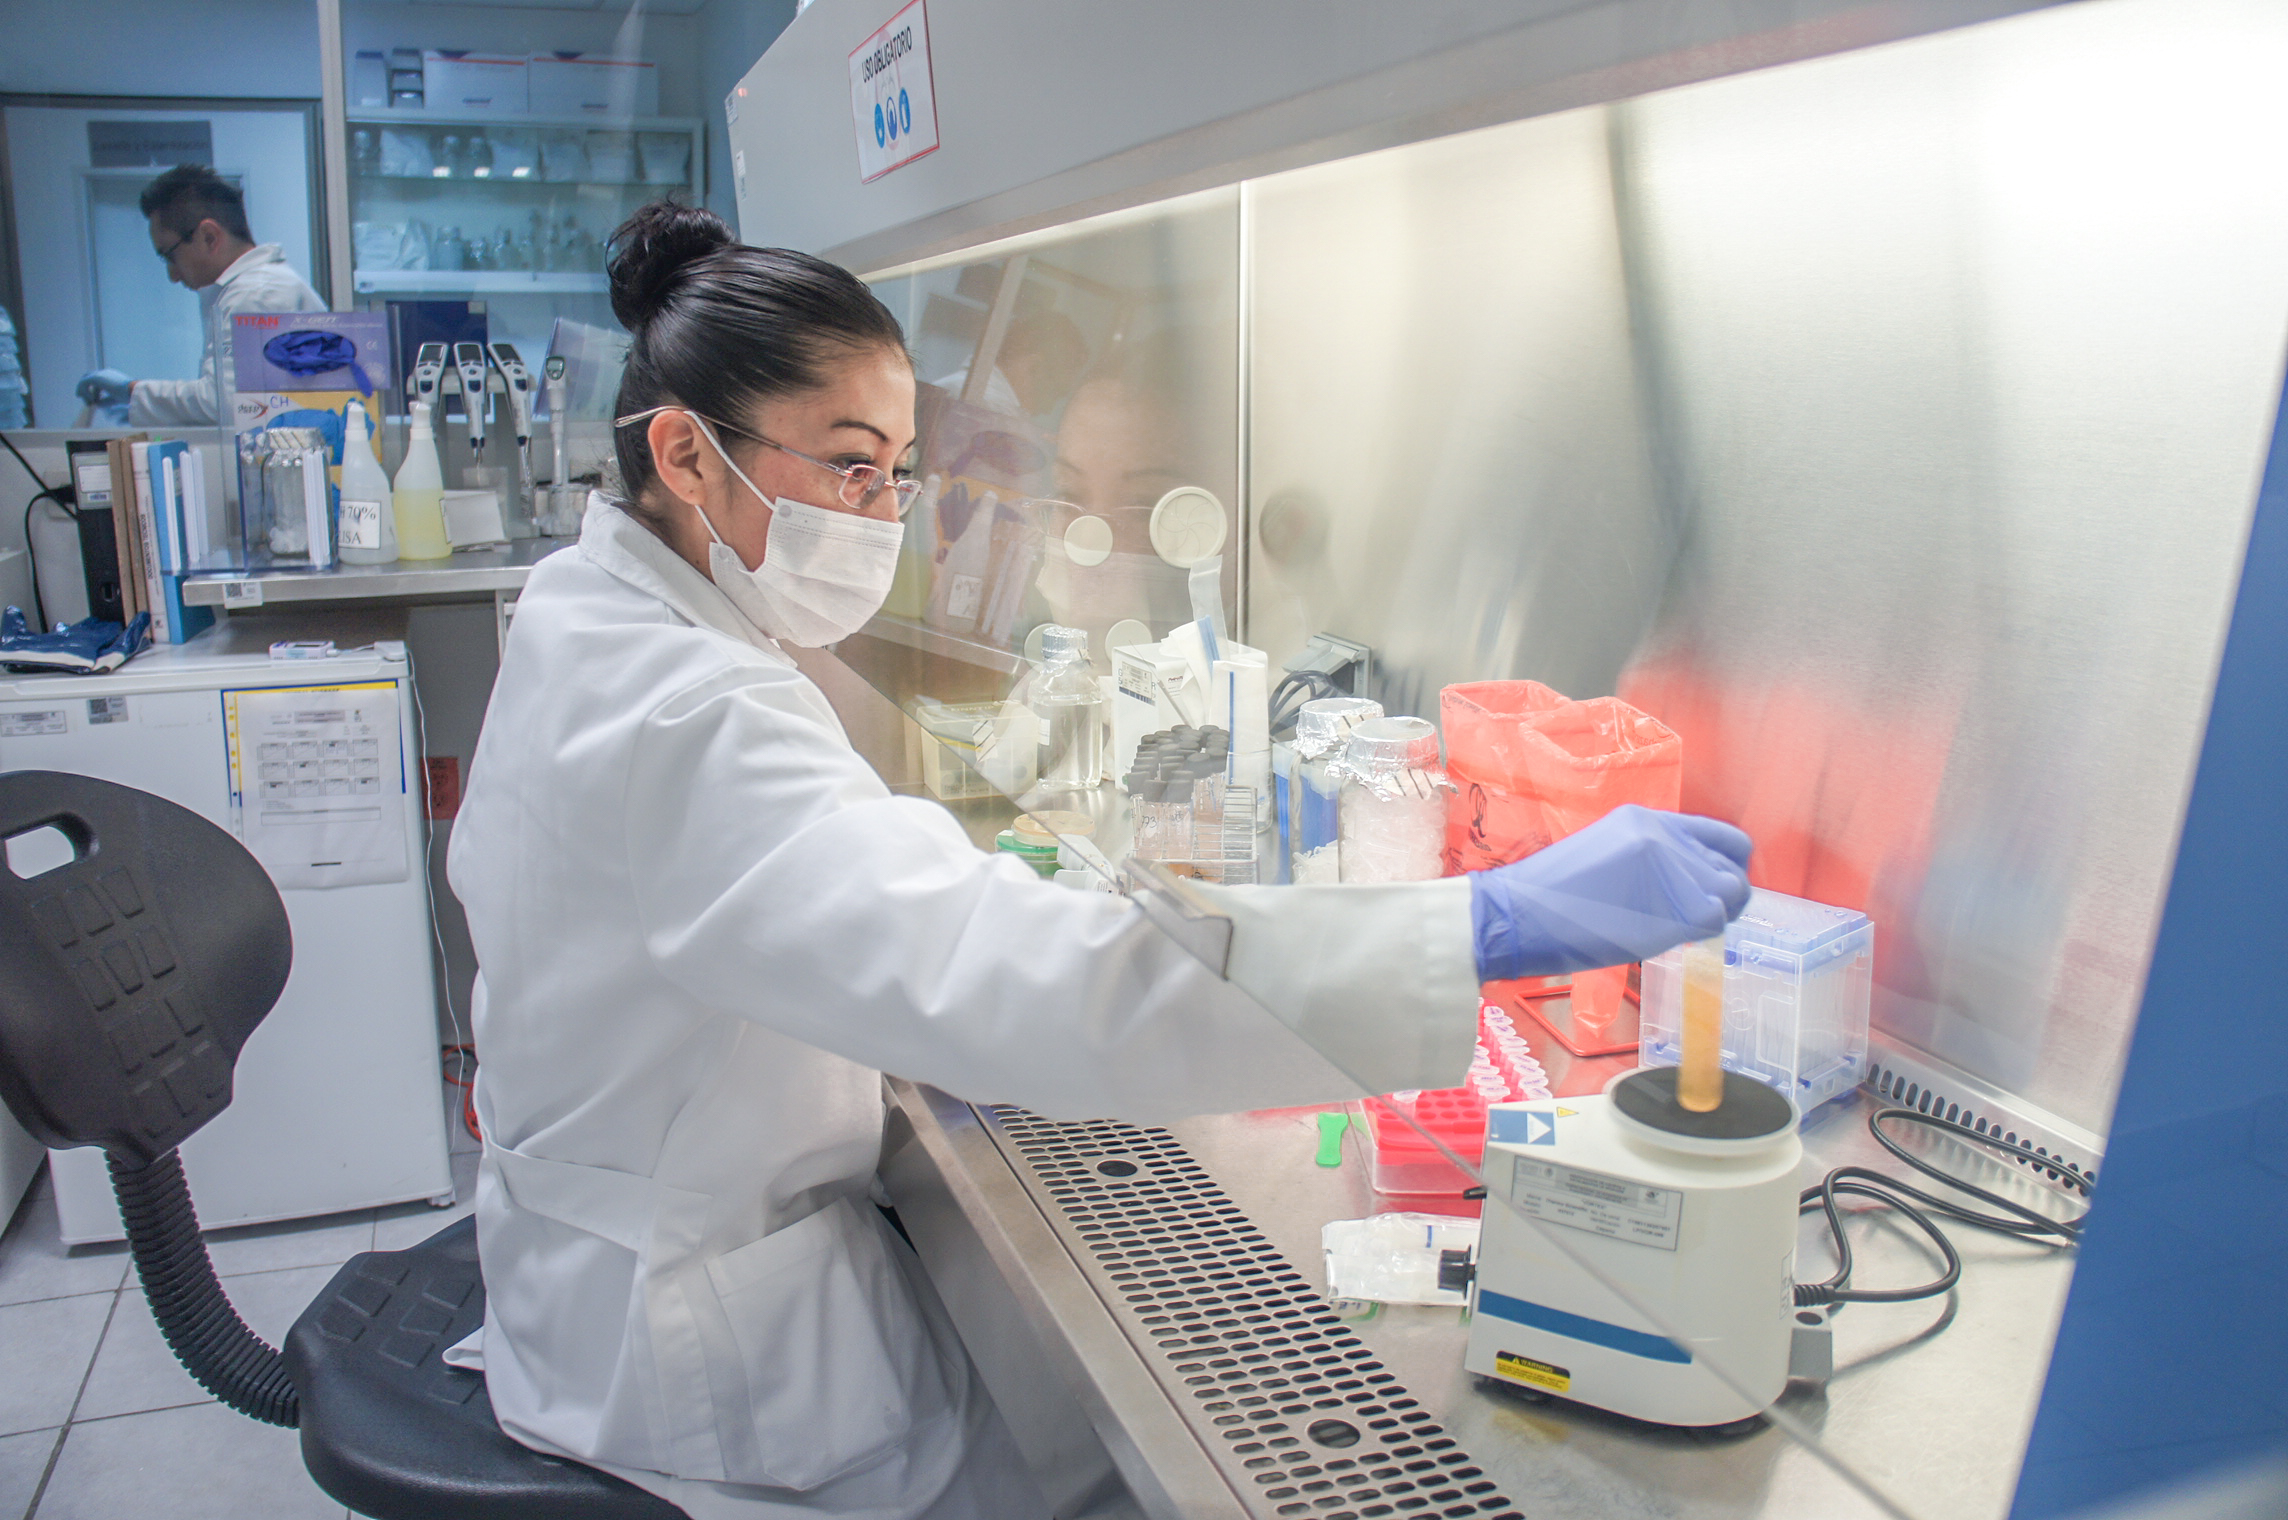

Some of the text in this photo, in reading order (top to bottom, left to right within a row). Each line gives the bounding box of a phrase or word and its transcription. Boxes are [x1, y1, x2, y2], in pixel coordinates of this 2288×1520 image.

[862, 26, 913, 83] USO OBLIGATORIO
[234, 315, 280, 327] TITAN
[270, 395, 289, 409] CH
[347, 506, 376, 520] 70%
[1520, 1359, 1554, 1374] WARNING
